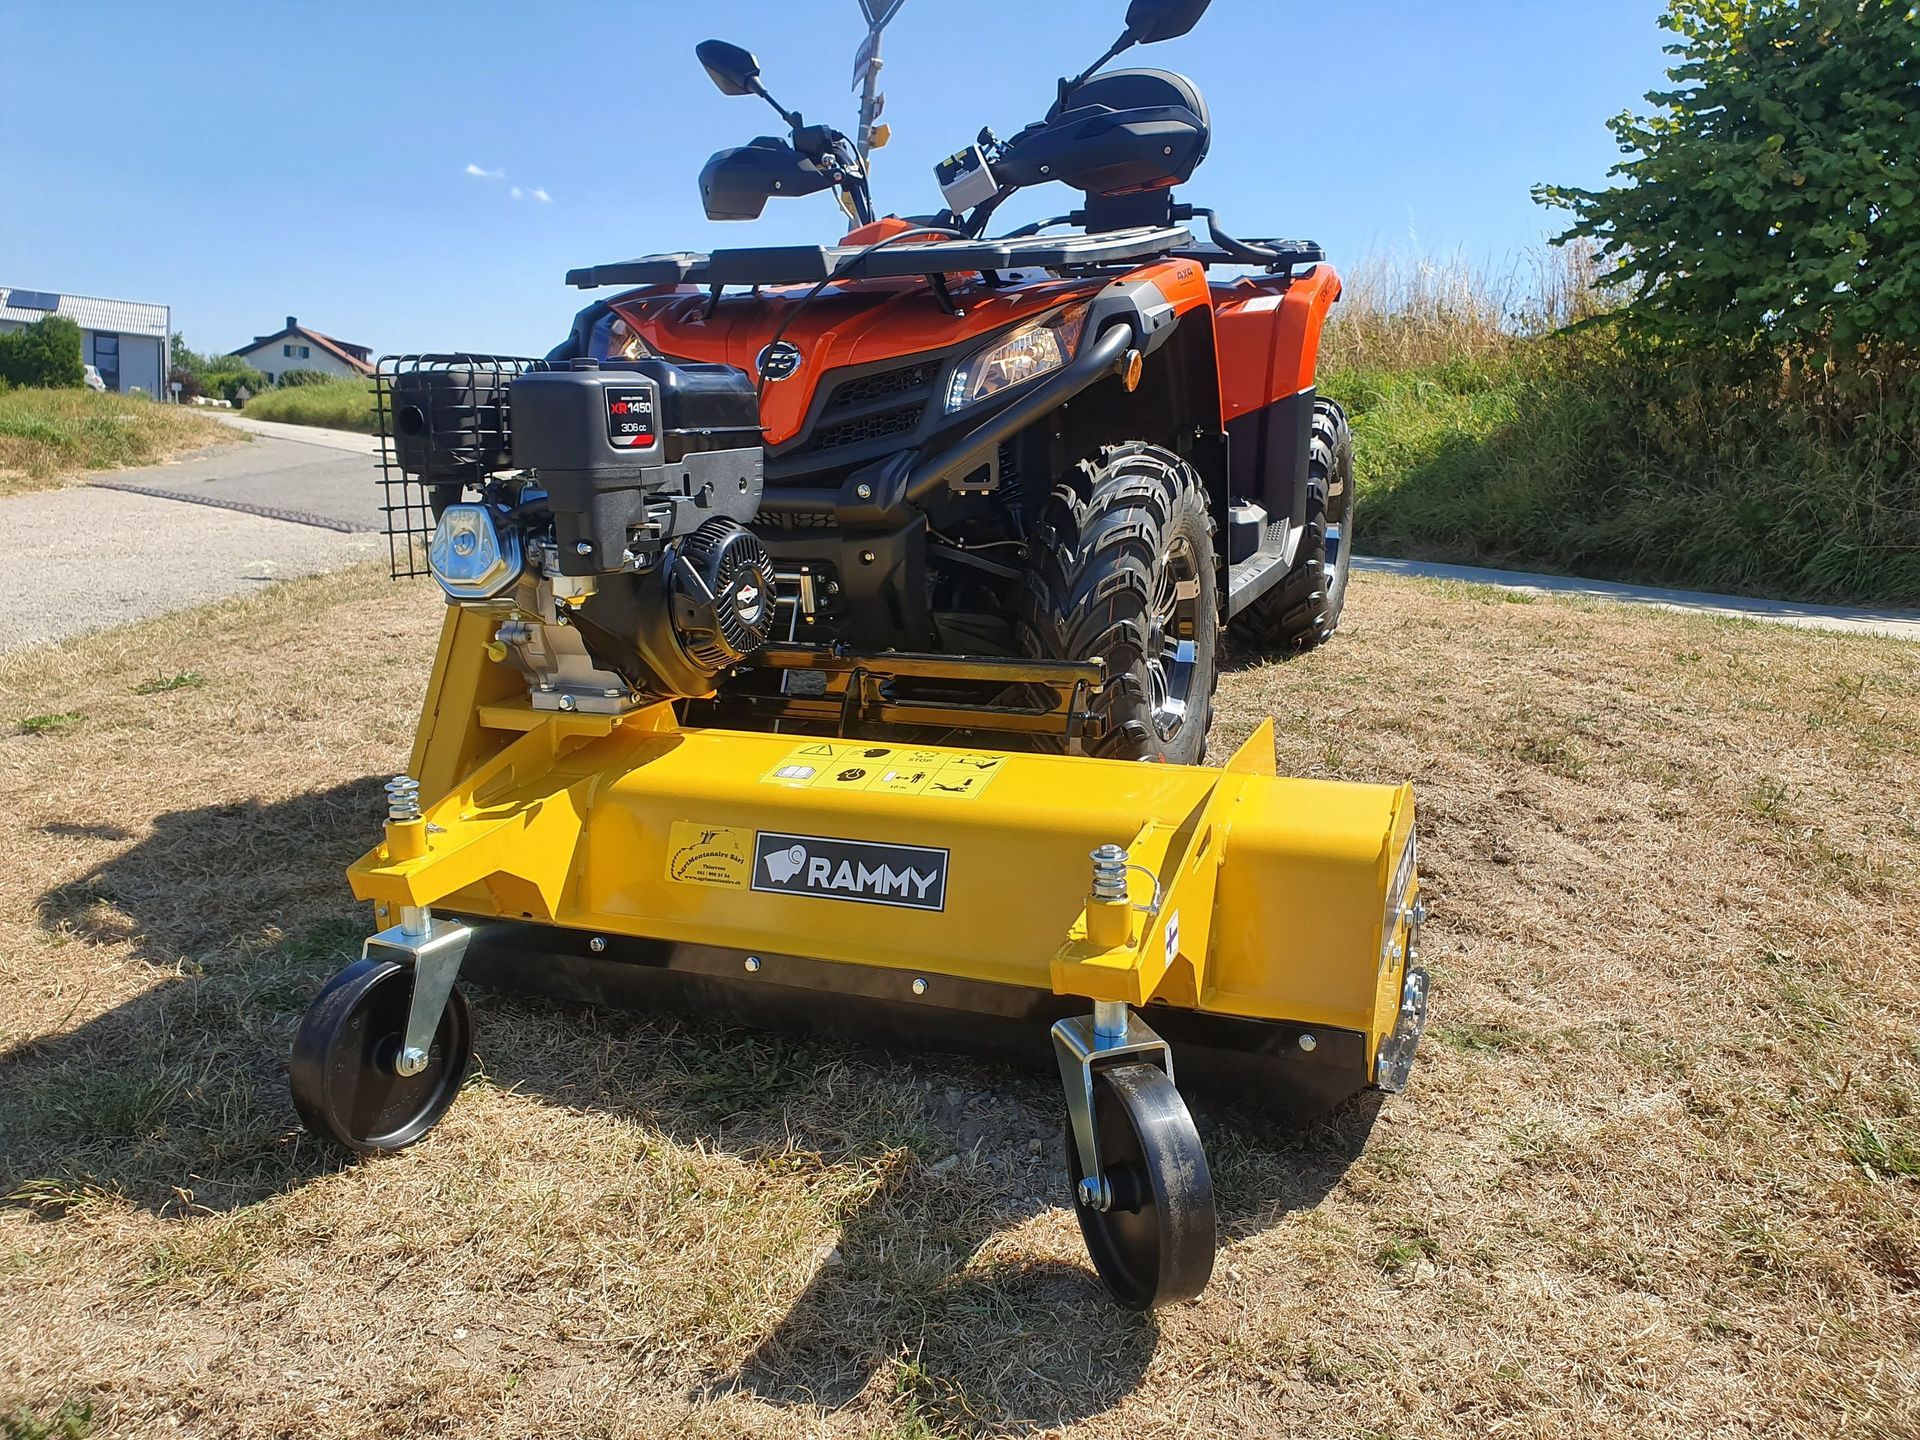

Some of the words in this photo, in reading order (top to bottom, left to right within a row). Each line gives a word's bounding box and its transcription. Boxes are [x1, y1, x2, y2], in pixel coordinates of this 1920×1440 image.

[611, 402, 651, 414] XR1450
[621, 423, 639, 432] 306
[639, 424, 647, 432] cc
[807, 856, 937, 899] RAMMY
